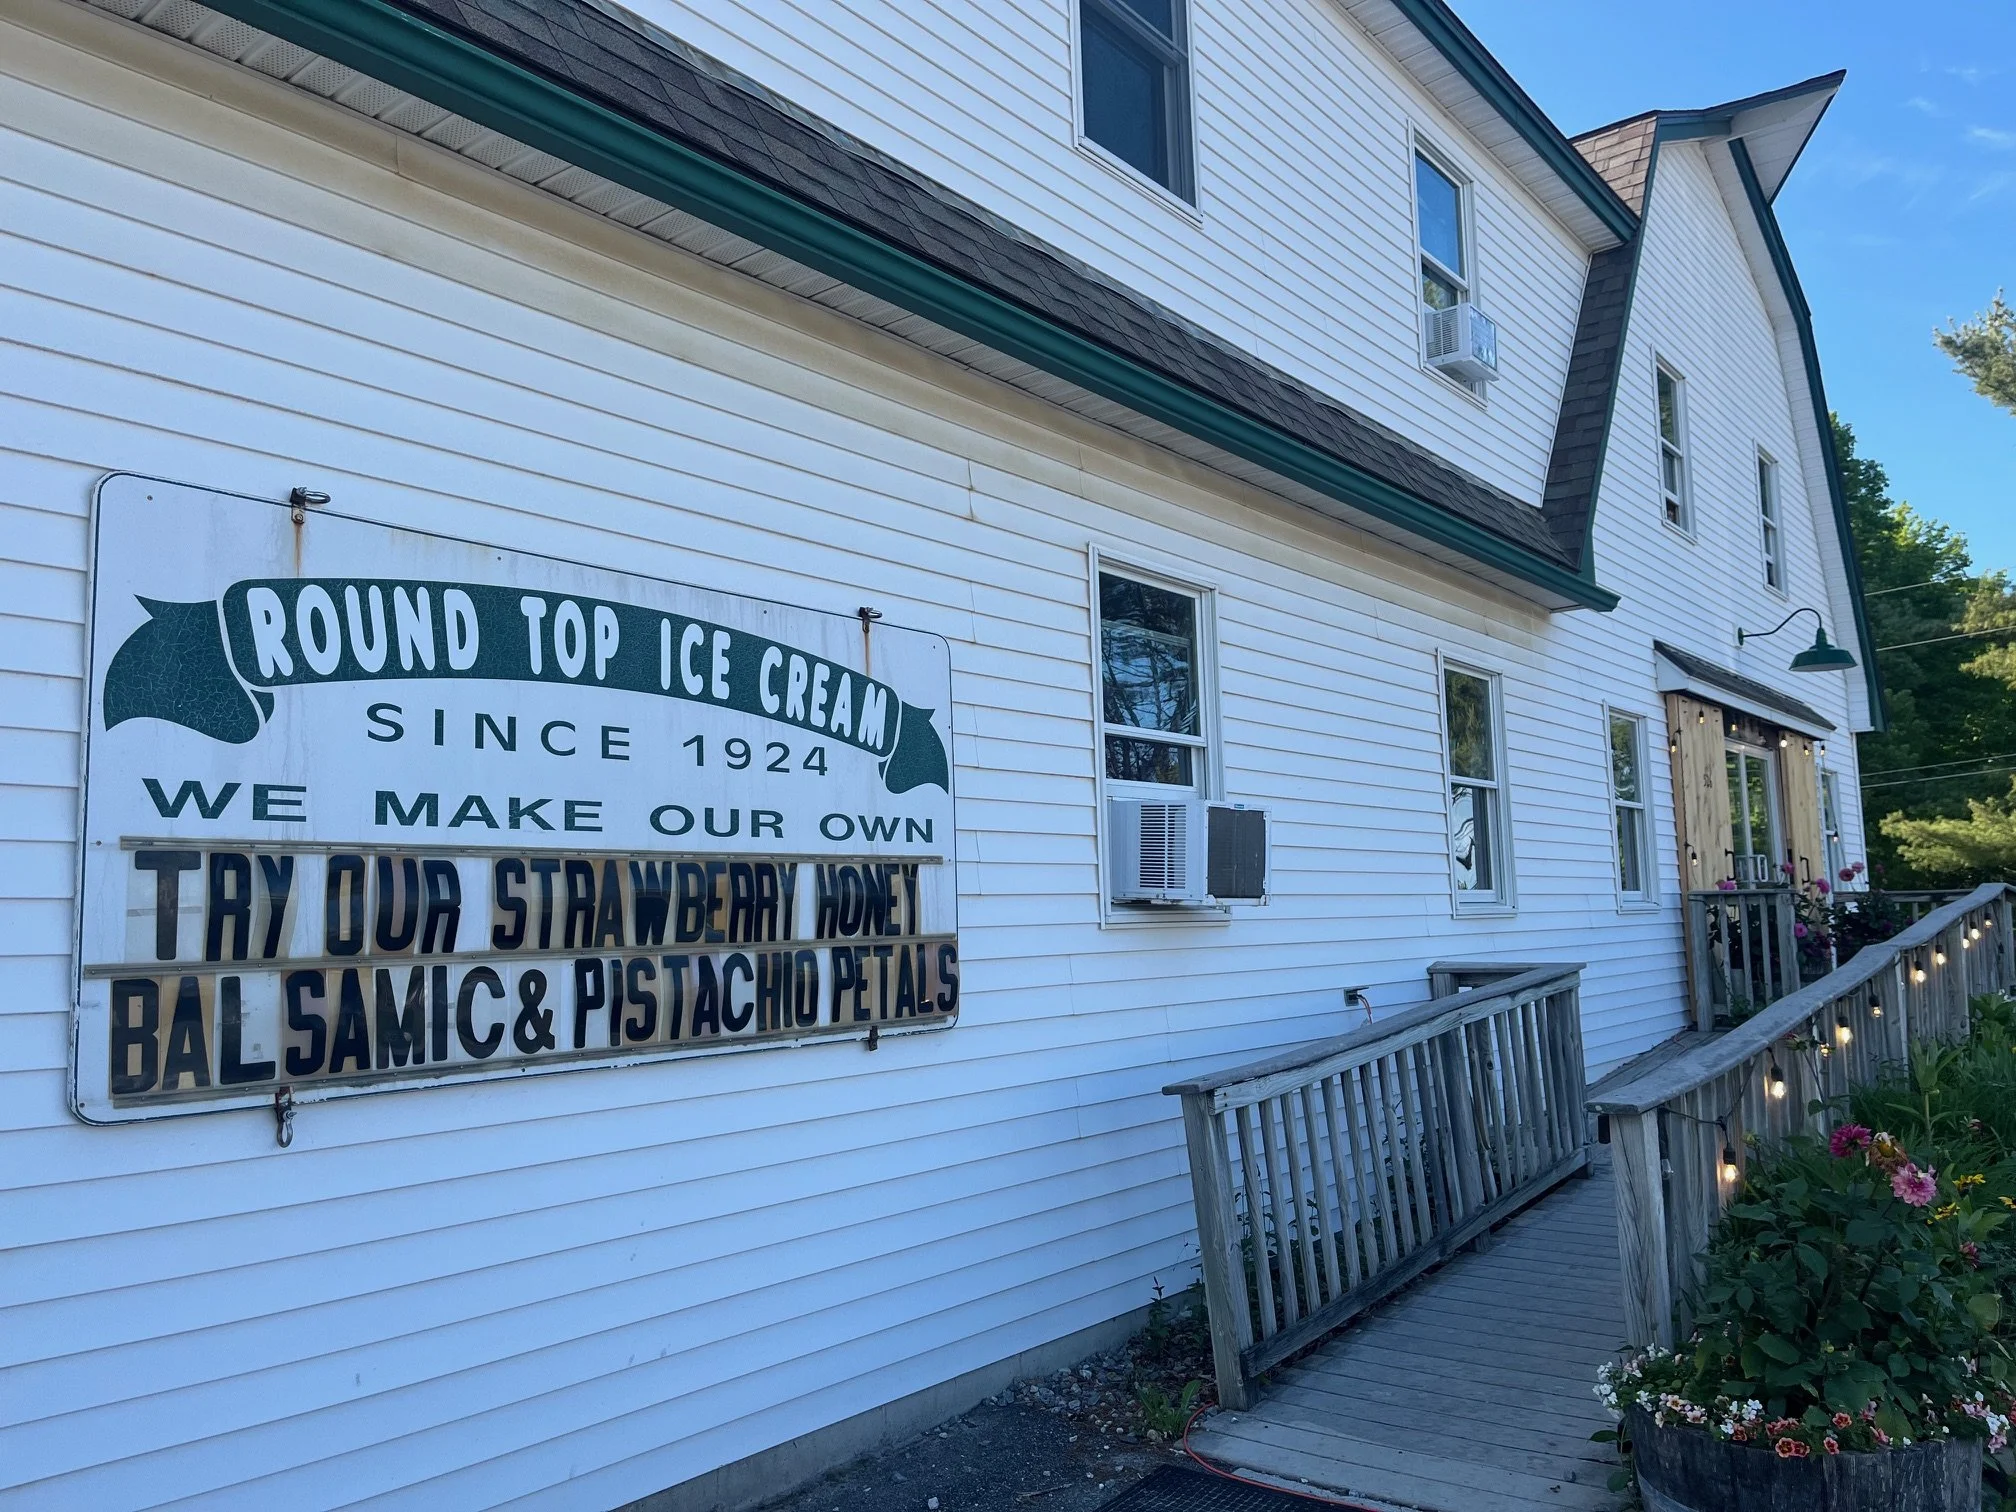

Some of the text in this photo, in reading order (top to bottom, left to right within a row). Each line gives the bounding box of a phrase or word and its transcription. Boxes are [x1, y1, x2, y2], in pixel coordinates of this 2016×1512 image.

[247, 584, 887, 750] ROUND TOP ICE CREAM
[366, 702, 828, 776] SINCE 1924
[142, 778, 933, 843] WE MAKE OUR OWN
[135, 850, 918, 962] TRY OUR STRAWBERRY HONEY
[574, 949, 818, 1049] PISTACHIO
[831, 943, 958, 1023] PETALS
